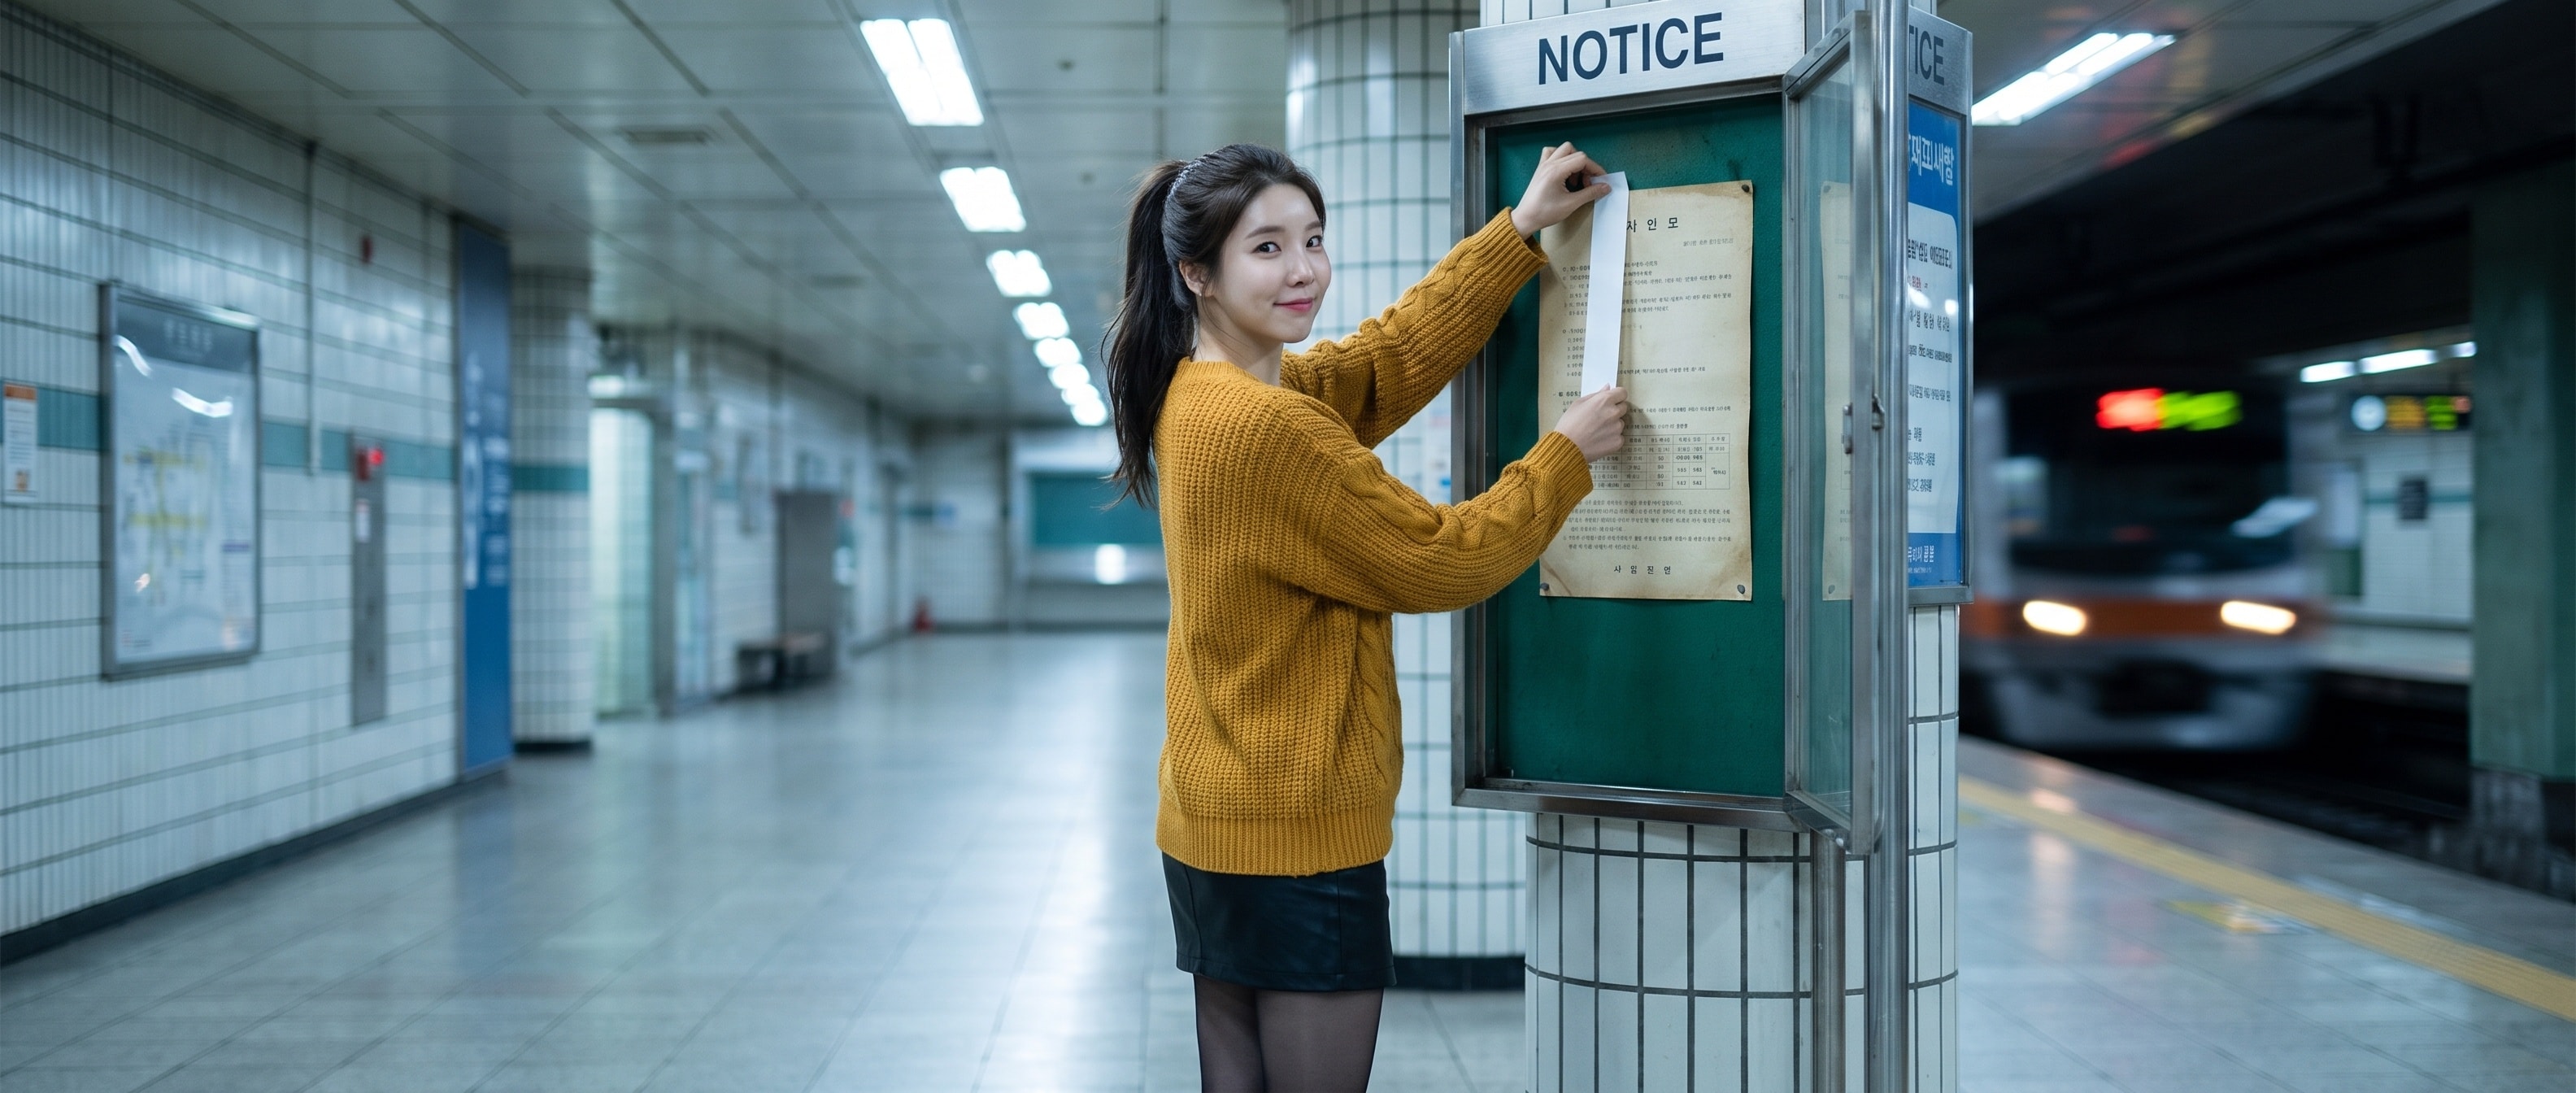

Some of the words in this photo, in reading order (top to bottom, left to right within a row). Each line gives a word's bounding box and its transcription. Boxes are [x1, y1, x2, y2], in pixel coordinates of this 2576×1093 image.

[1538, 12, 1724, 85] NOTICE
[1647, 217, 1657, 231] 인
[1668, 216, 1679, 229] 모
